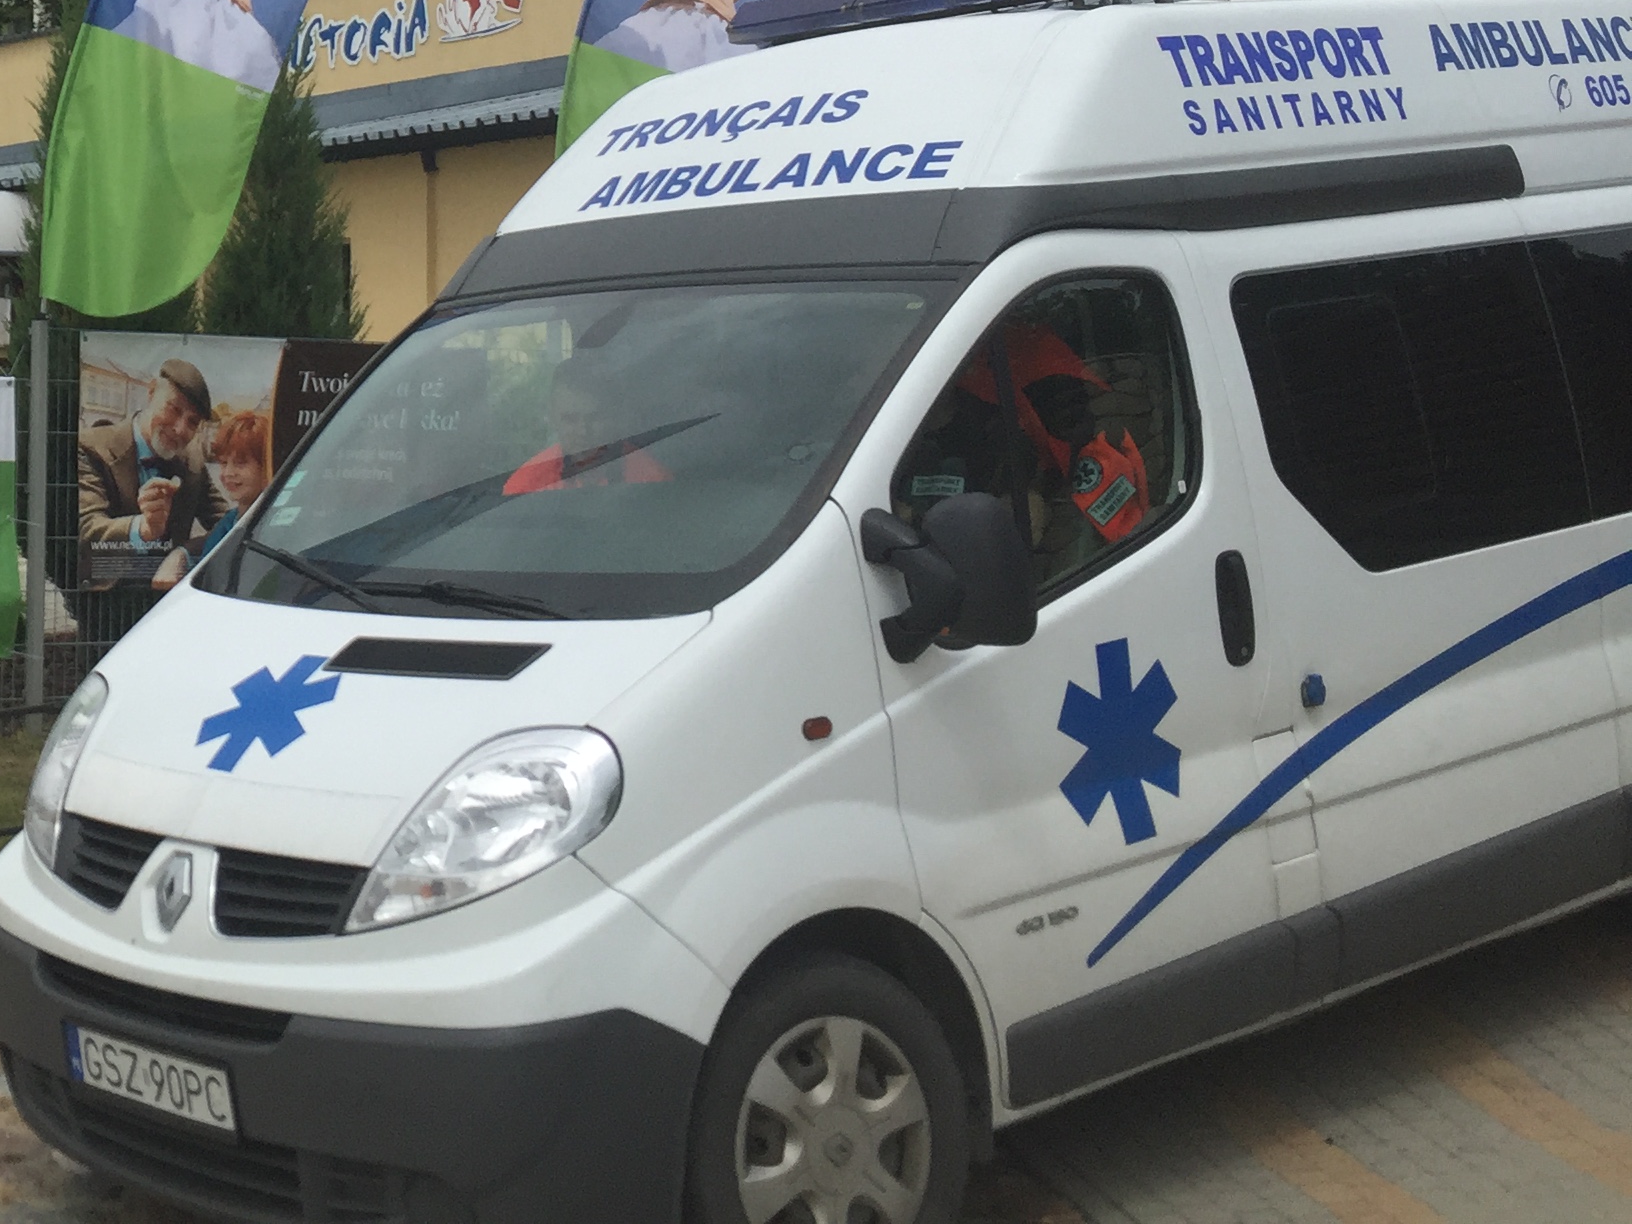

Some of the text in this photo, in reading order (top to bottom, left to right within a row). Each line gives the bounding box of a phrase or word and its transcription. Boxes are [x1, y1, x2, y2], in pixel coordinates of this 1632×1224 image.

[1157, 26, 1391, 88] TRANSPORT
[1429, 16, 1632, 72] AMBULANC
[1183, 87, 1409, 136] SANITARNY
[1584, 74, 1631, 108] 605
[596, 89, 869, 157] TRONÇAIS
[578, 140, 964, 212] AMBULANCE
[83, 1036, 228, 1122] GSZ 90PC
